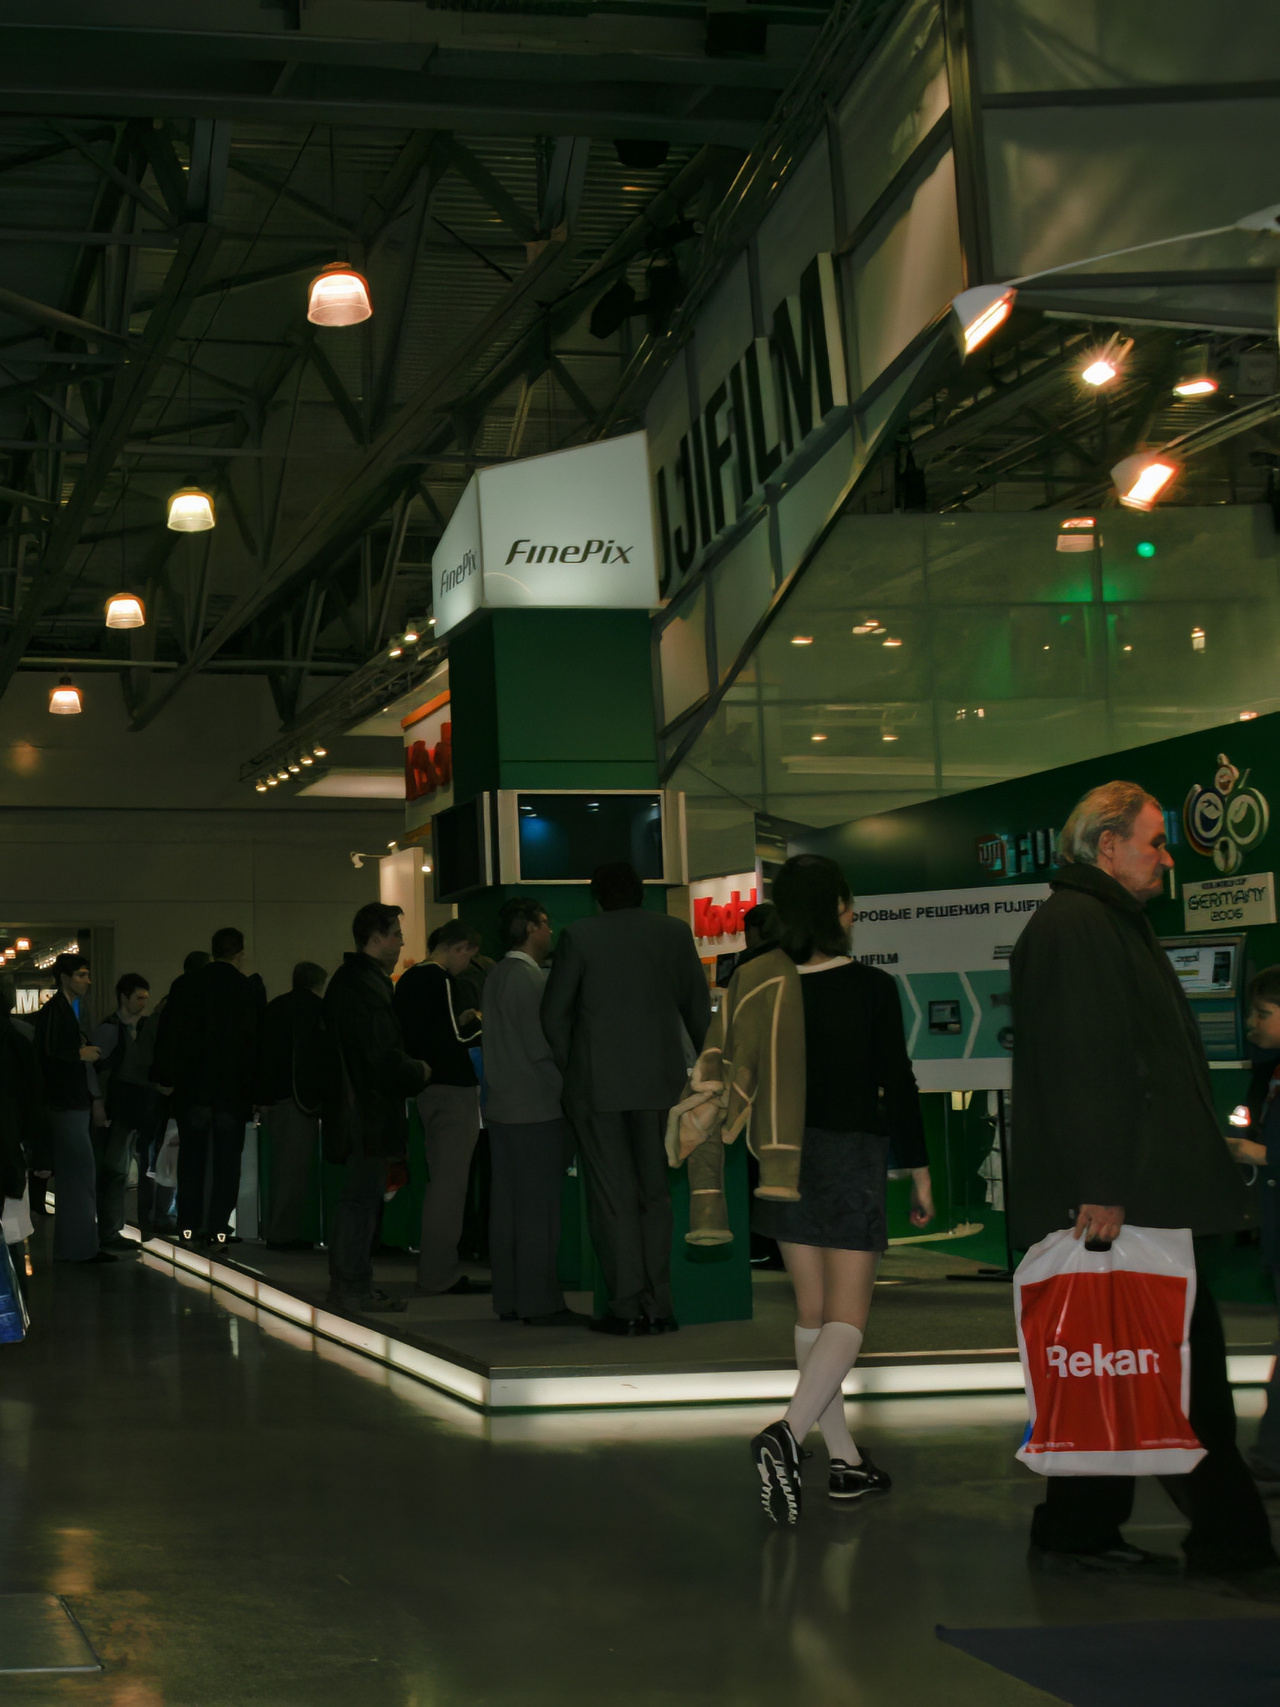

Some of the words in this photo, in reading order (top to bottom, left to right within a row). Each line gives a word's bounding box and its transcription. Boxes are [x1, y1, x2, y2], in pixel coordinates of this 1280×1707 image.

[505, 540, 634, 566] FinePix
[440, 549, 477, 598] FinePix
[916, 902, 990, 918] РЕШЕНИЯ
